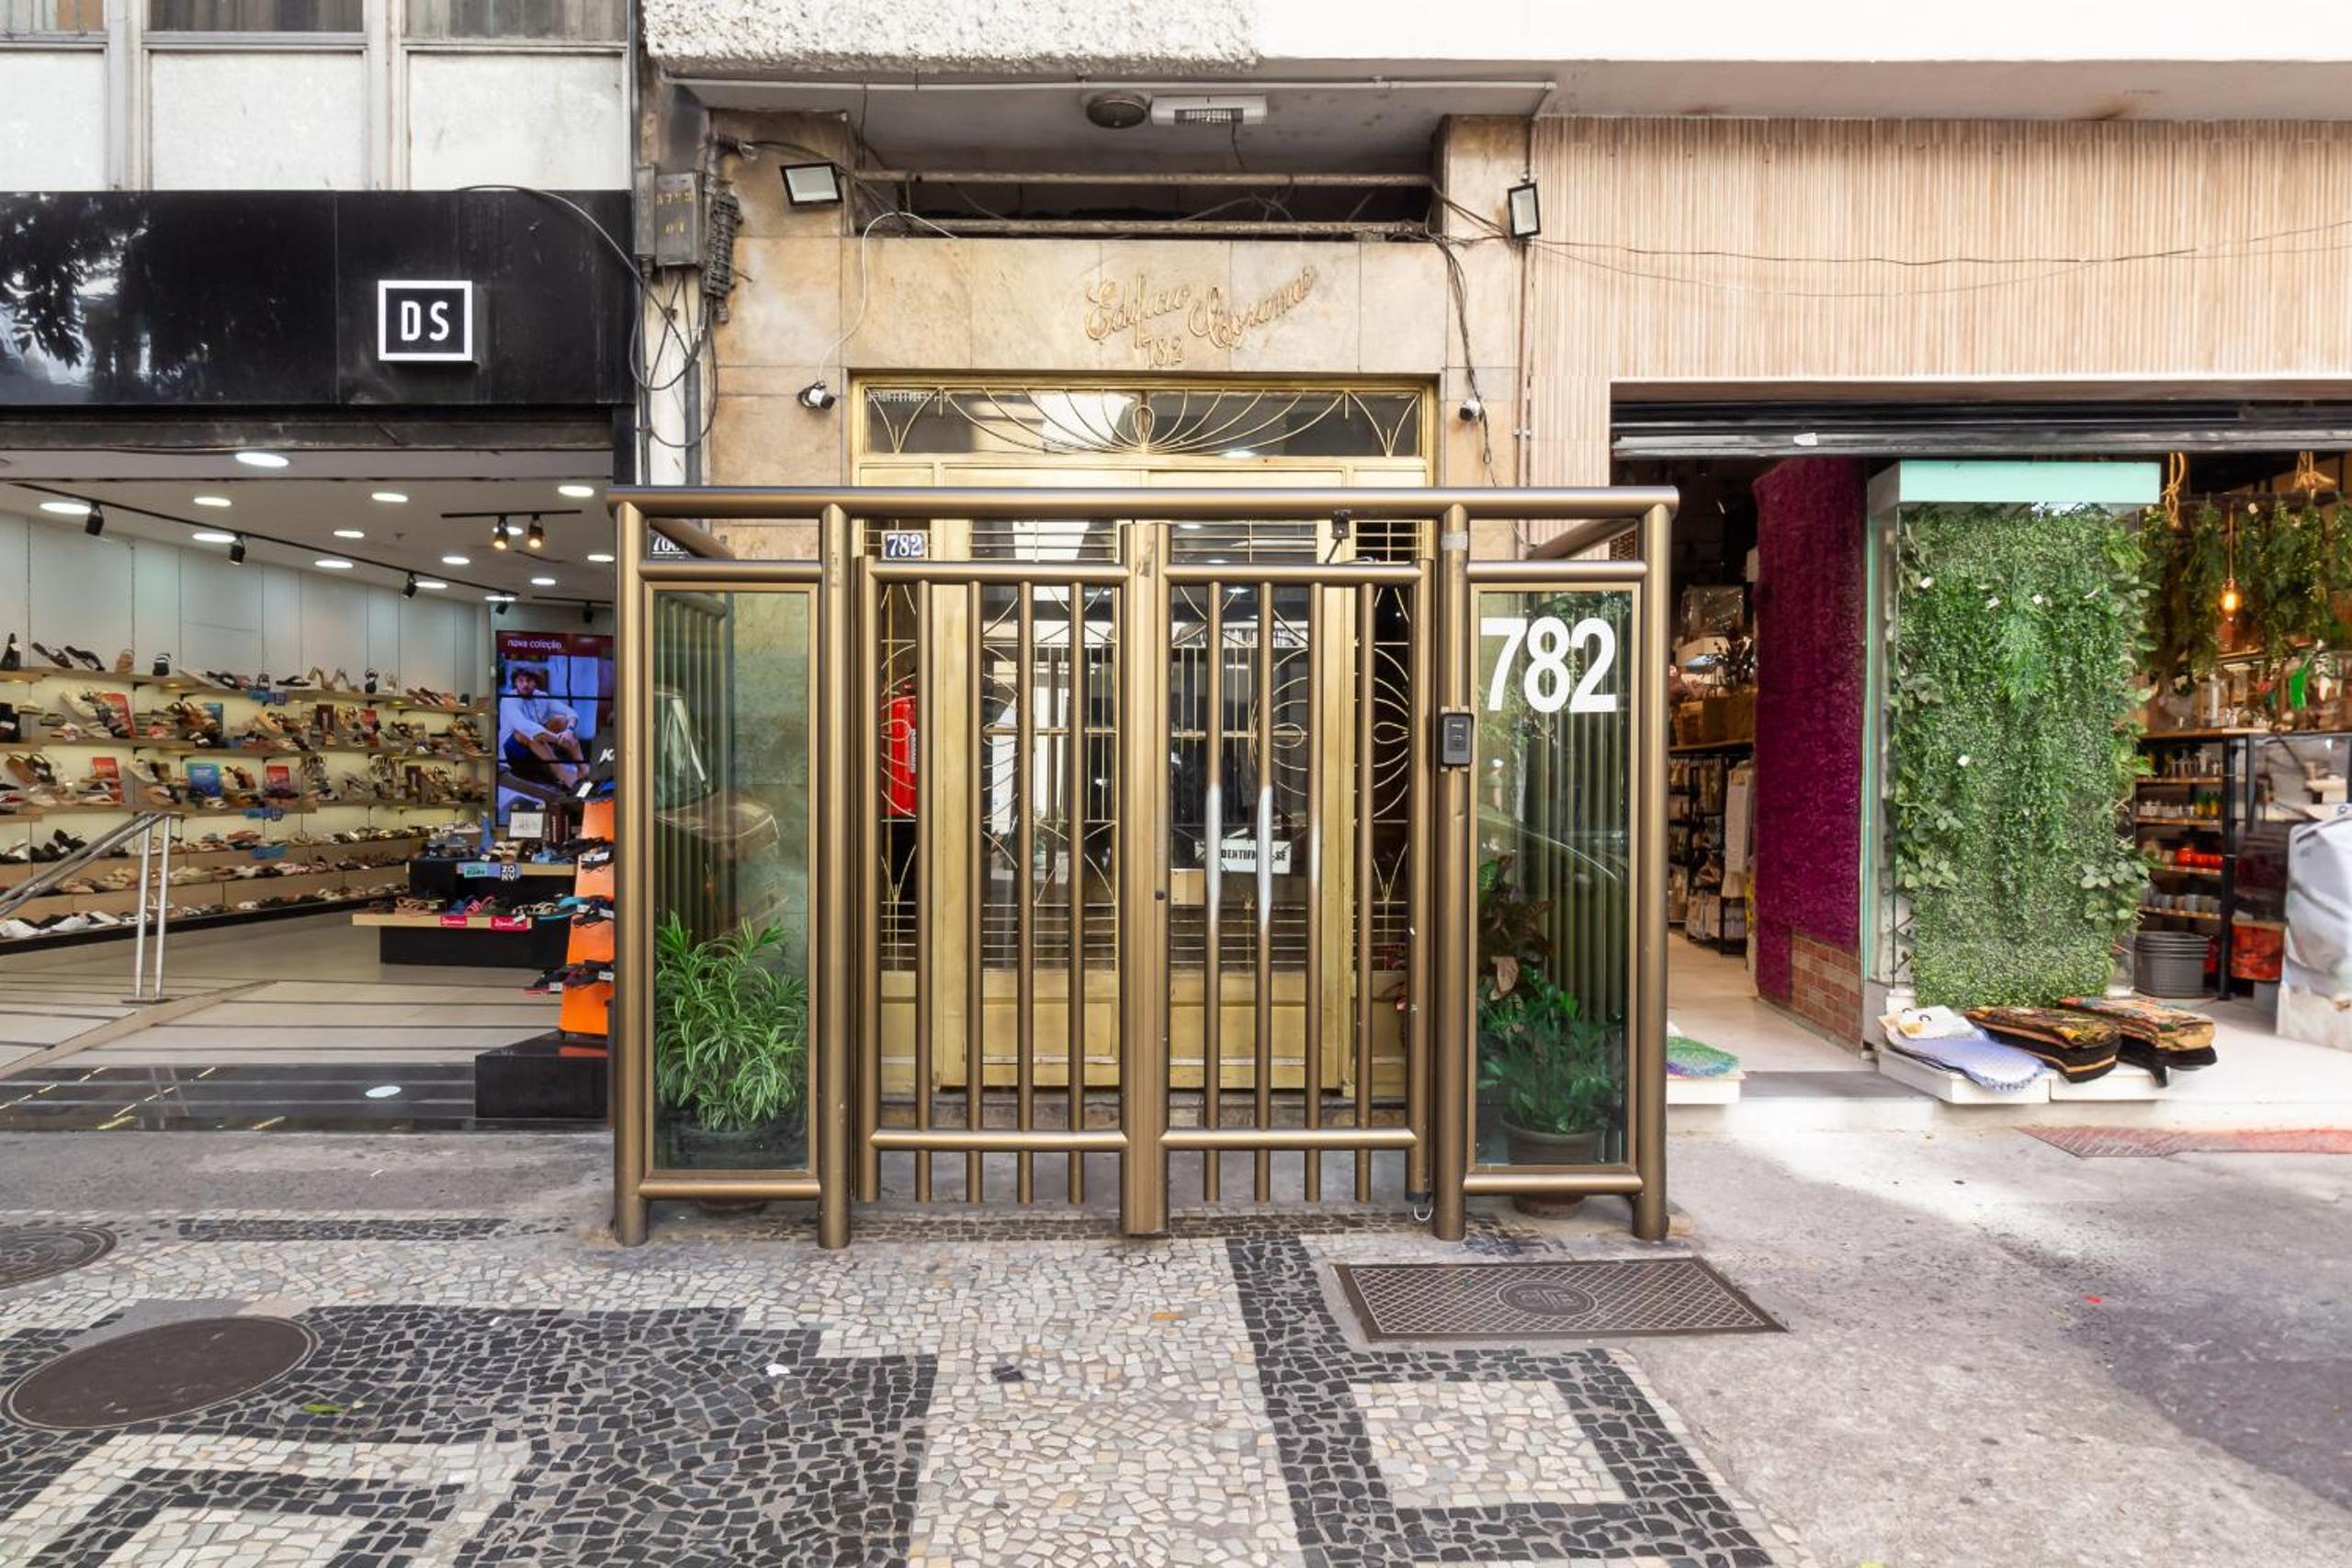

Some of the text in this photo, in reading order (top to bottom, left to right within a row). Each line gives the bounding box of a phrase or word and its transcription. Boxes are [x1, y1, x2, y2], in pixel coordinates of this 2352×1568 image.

[401, 300, 449, 342] DS
[1143, 336, 1185, 369] 782
[887, 534, 923, 557] 782
[1480, 615, 1618, 713] 782
